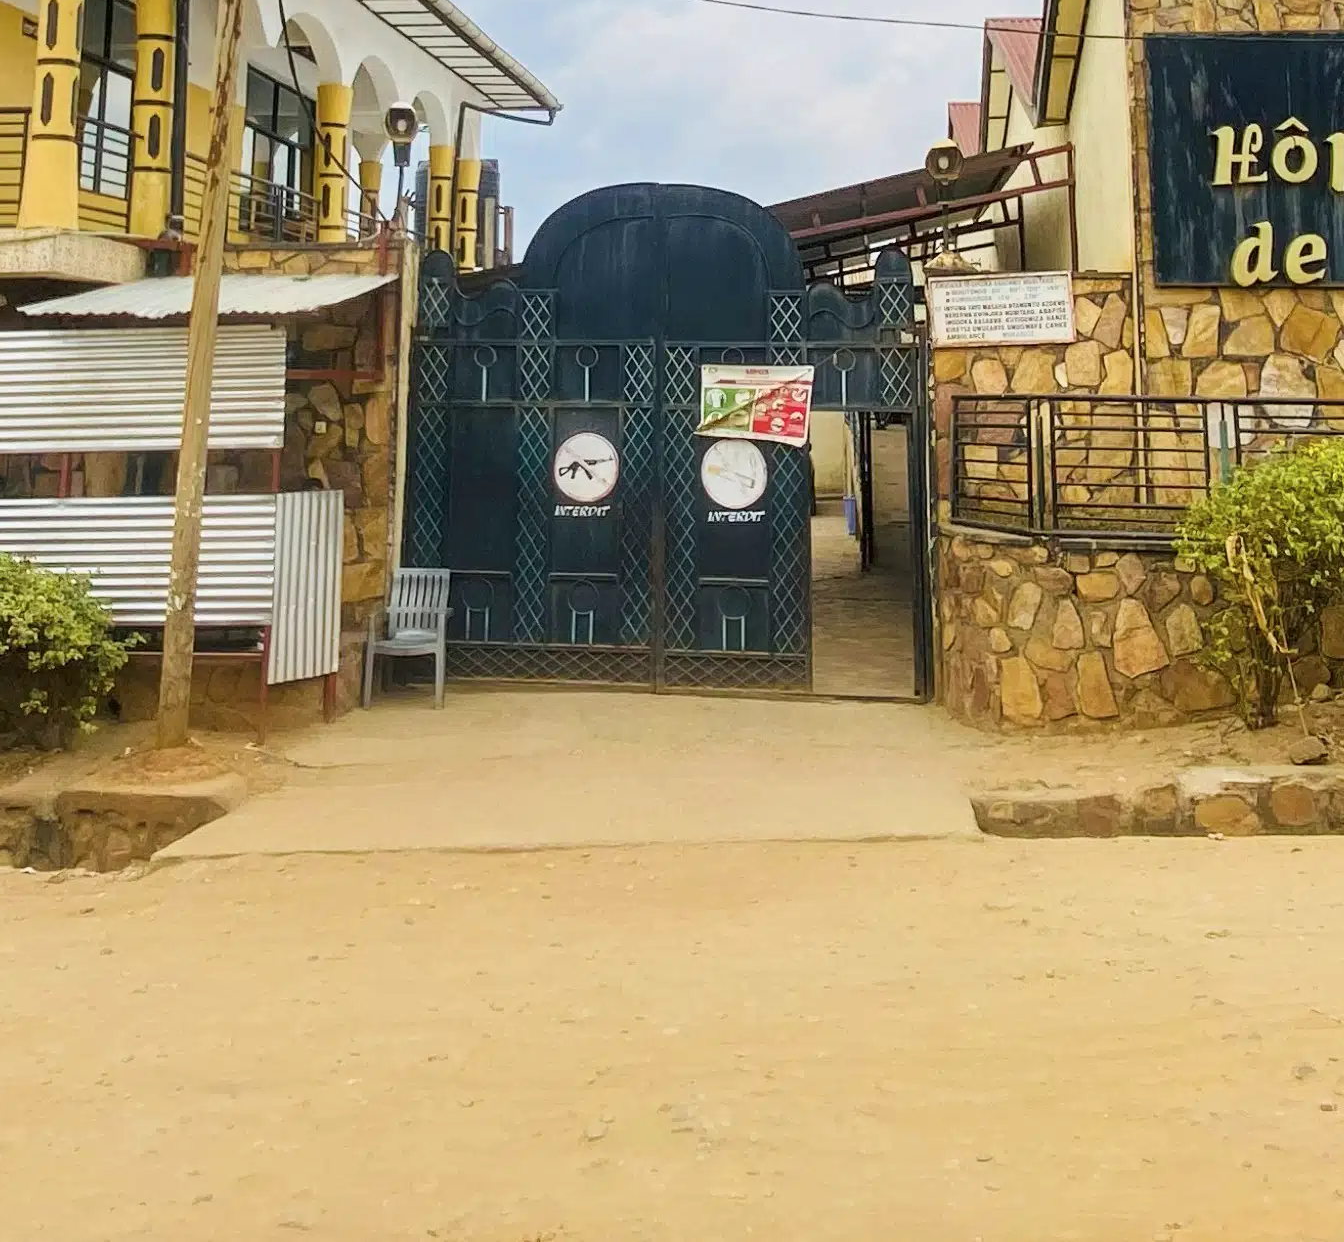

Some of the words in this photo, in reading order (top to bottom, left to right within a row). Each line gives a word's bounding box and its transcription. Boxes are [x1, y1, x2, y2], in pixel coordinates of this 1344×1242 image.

[1231, 220, 1327, 288] de
[554, 504, 610, 518] INTERDIT
[707, 510, 766, 524] INTERDIT
